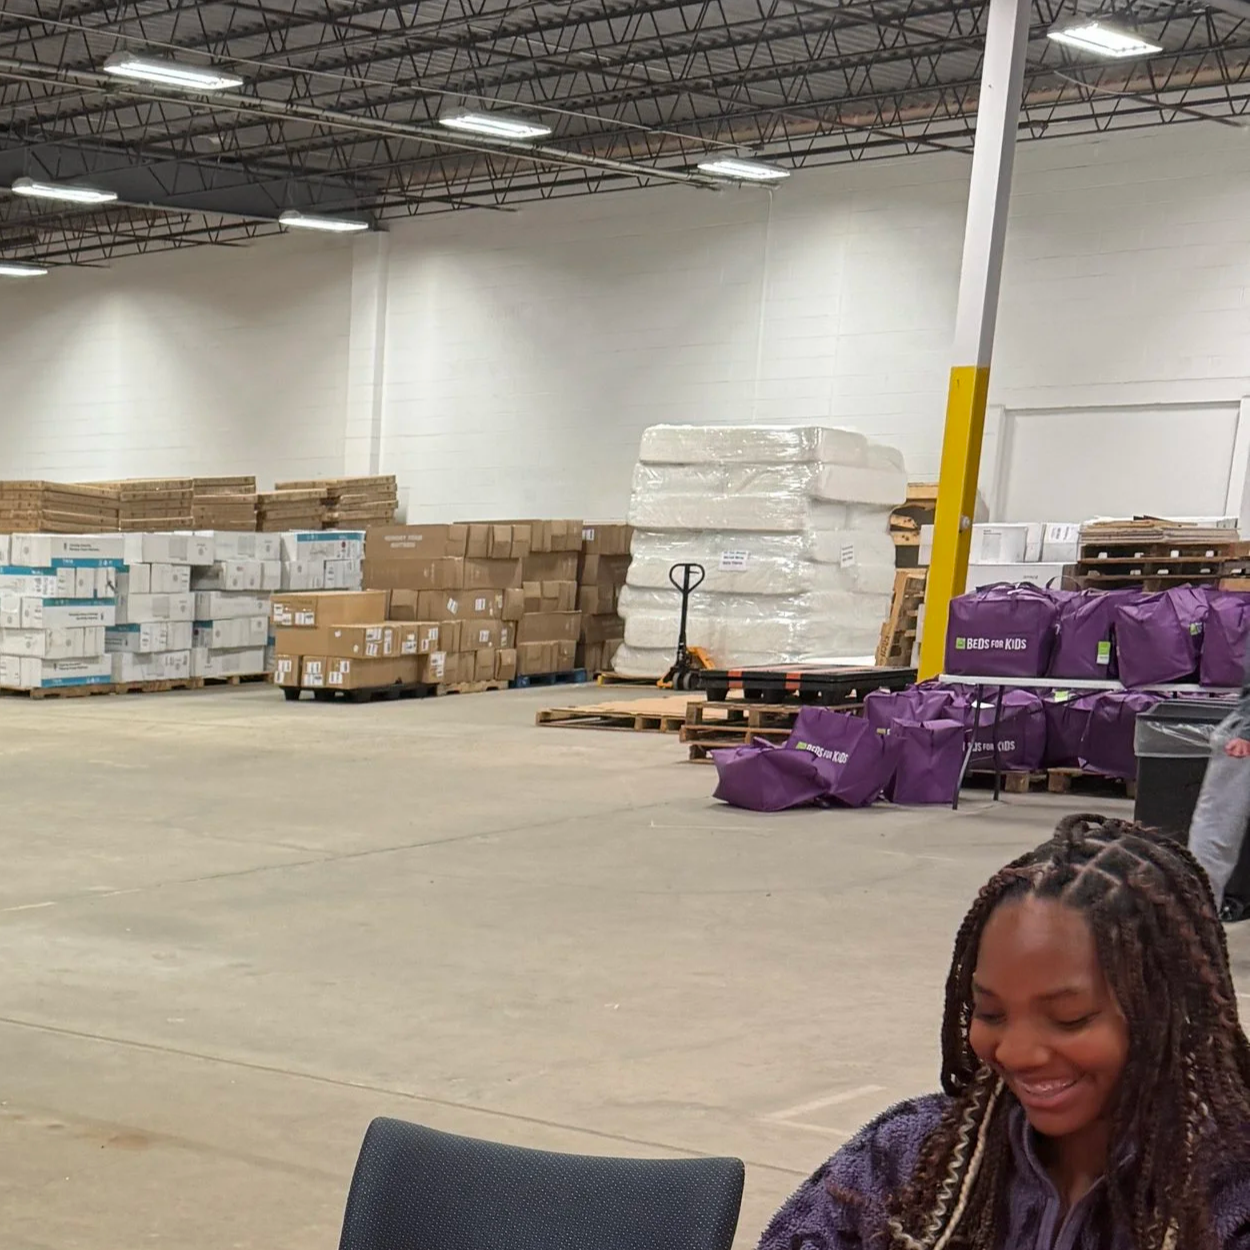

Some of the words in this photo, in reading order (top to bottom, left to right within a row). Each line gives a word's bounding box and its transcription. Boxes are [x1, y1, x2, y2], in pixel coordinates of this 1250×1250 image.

[967, 638, 990, 650] BEDS
[991, 639, 1004, 649] FOR
[1005, 638, 1027, 650] KIDS
[983, 742, 995, 751] FOR
[823, 750, 833, 759] FOR
[832, 751, 848, 763] KIDS
